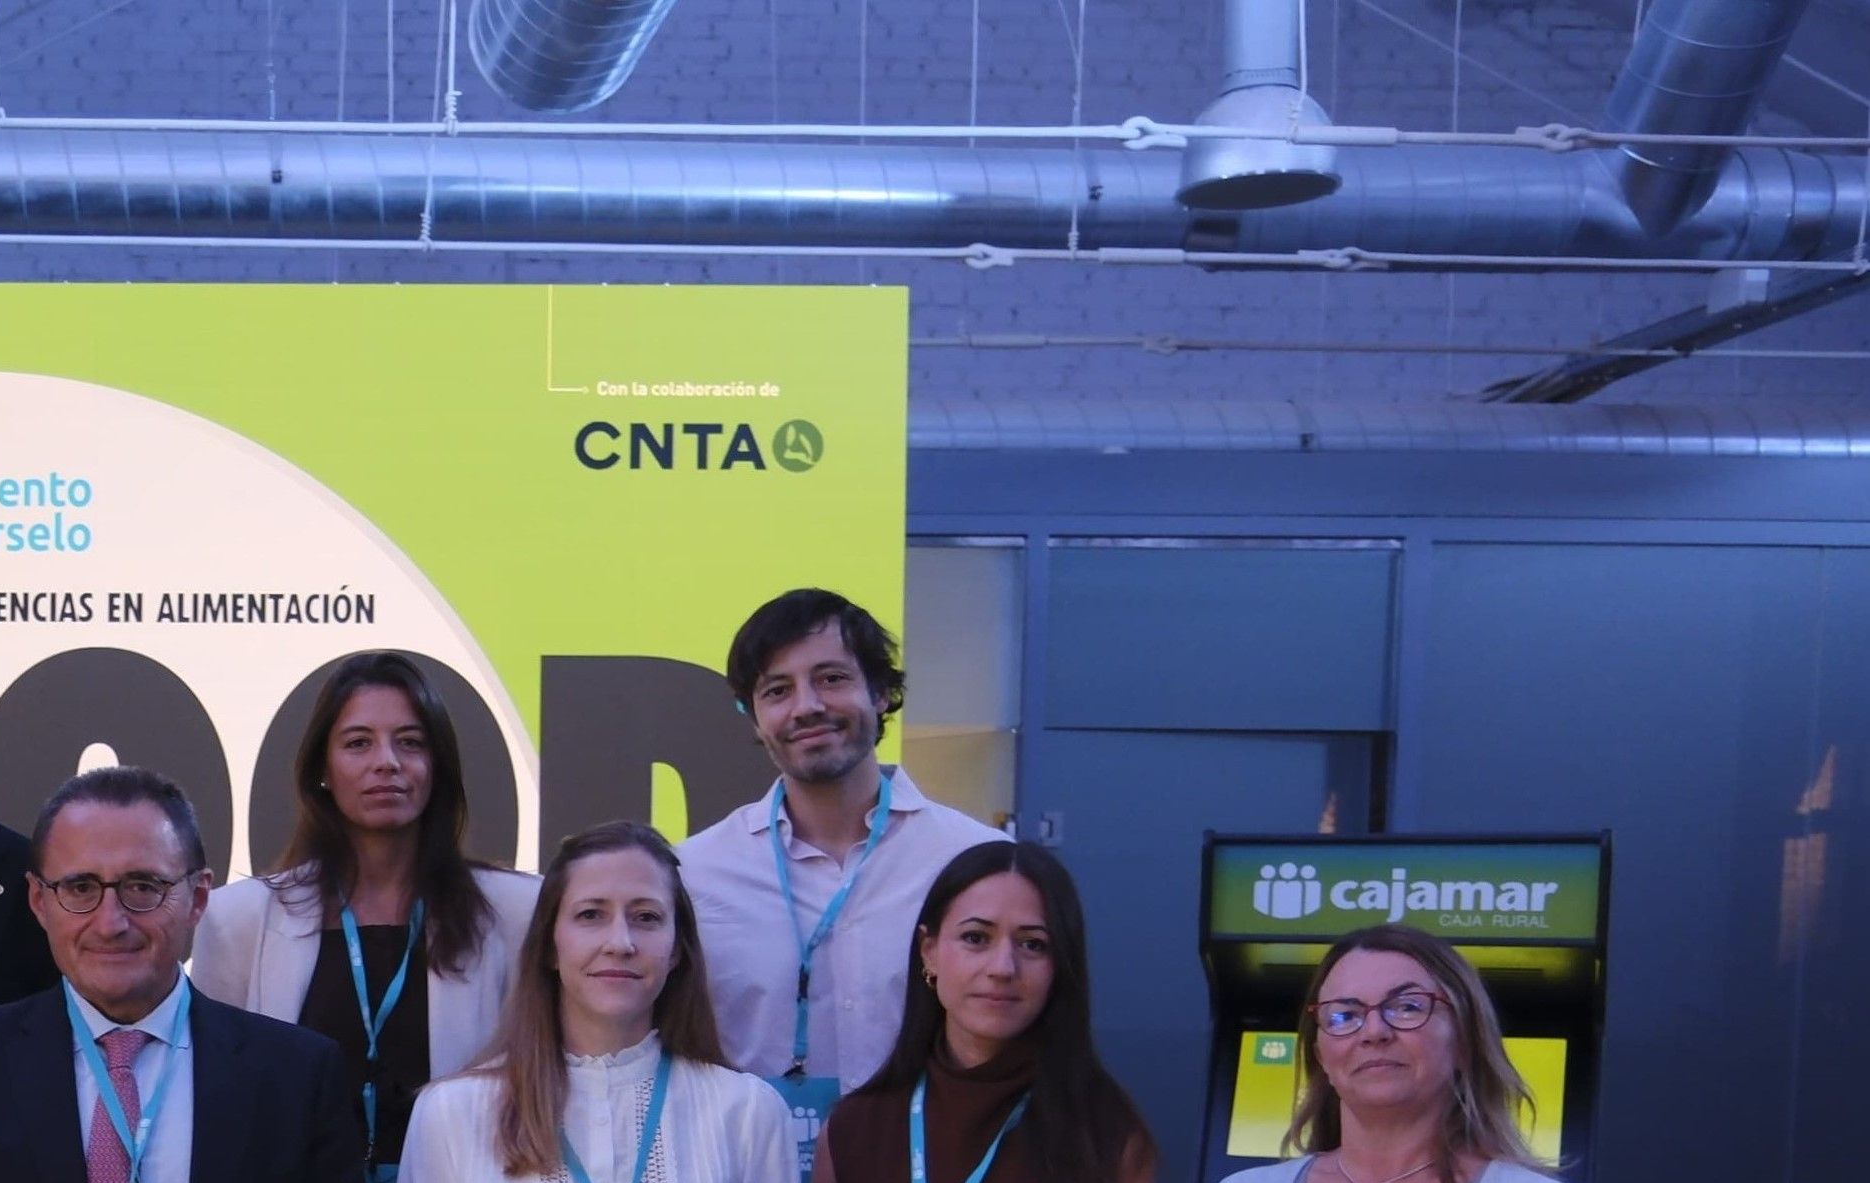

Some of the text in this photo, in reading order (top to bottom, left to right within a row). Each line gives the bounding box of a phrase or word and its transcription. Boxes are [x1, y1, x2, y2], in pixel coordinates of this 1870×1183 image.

[596, 381, 781, 397] Con la colaboración de
[574, 421, 768, 470] CNTA
[107, 592, 144, 623] EN
[156, 584, 376, 624] ALIMENTACIÓN
[1329, 867, 1560, 924] cajamar
[1438, 913, 1550, 929] CAJA RURAL
